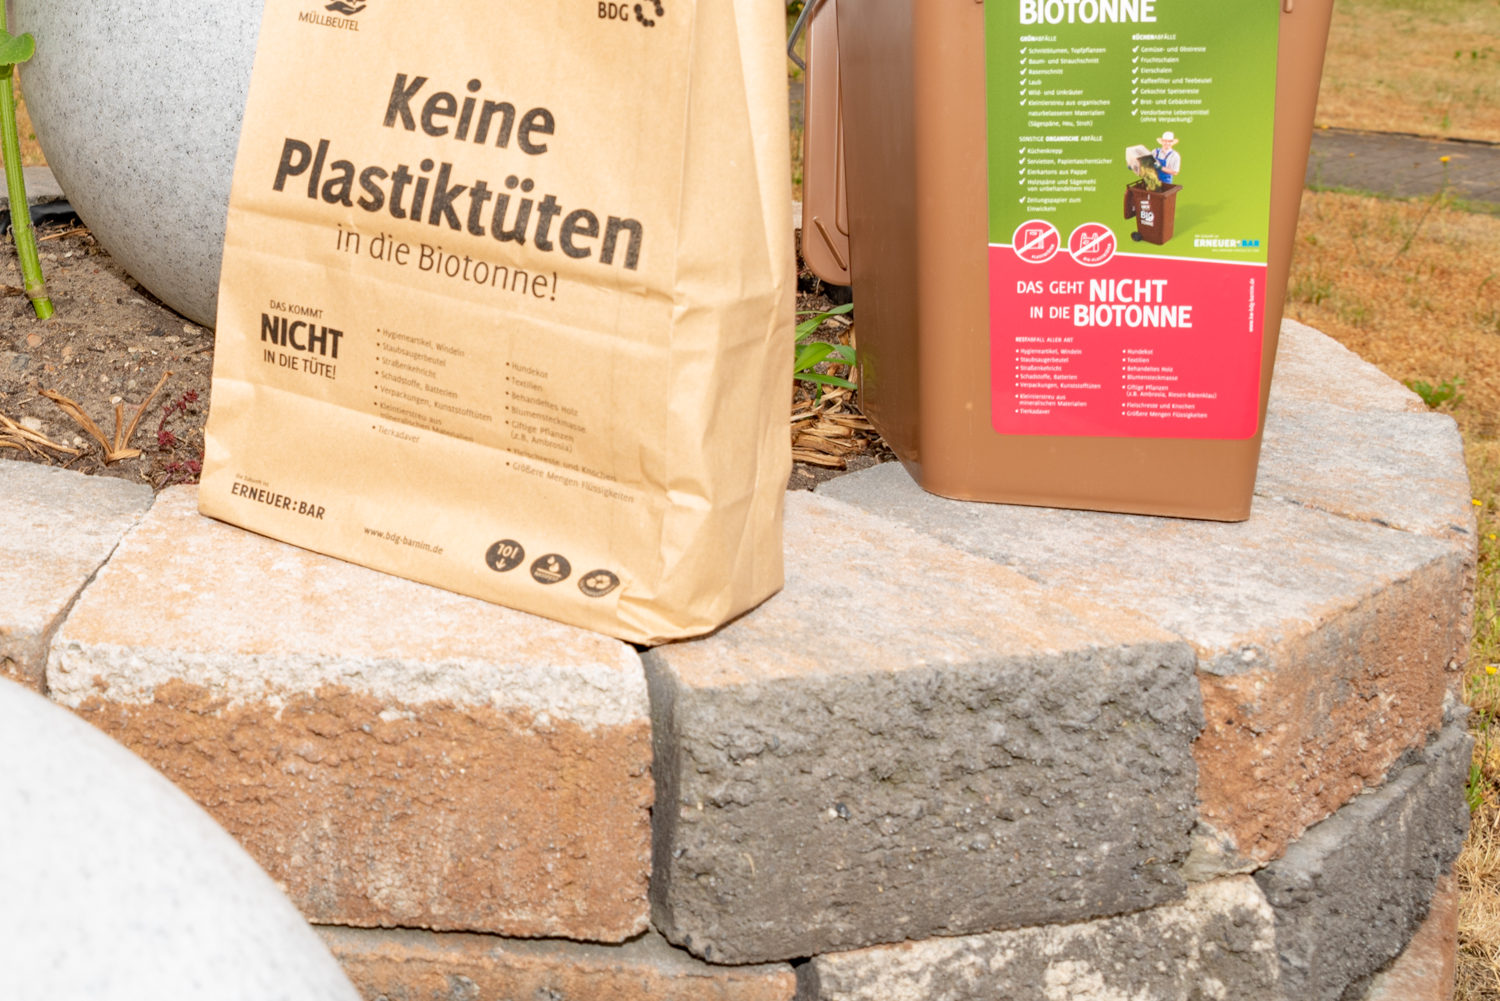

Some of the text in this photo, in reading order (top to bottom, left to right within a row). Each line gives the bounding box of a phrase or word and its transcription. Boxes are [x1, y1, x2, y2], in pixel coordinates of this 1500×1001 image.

[299, 11, 359, 32] MÜLLBEUTEL
[598, 1, 629, 22] BDG
[383, 73, 555, 156] Keine
[273, 138, 643, 271] Plastiktüten
[337, 223, 558, 302] in die Biotonne!
[1017, 279, 1168, 303] DAS GEHT NICHT
[270, 300, 323, 319] DAS KOMMT
[1030, 304, 1193, 328] IN DIE BIOTONNE
[261, 313, 344, 359] NICHT
[383, 329, 465, 357] Hygieneartikel, Windeln
[264, 349, 336, 380] IN DIE TÜTE!
[383, 342, 446, 367] Staubsaugerbeutel
[382, 357, 436, 379] Straßenkehricht
[512, 362, 548, 379] Hundekot
[381, 371, 458, 399] Schadstoffe, Batterien
[511, 376, 543, 392] Textilien
[380, 385, 492, 422] Verpackungen, Kunststofftüten
[380, 402, 443, 426] Kleintierstreu aus
[511, 391, 579, 417] Behandeltes Holz
[511, 406, 586, 434] Blumensteckmasse
[511, 420, 574, 443] Giftige Pflanzen
[379, 425, 421, 443] Tierkadaver
[511, 430, 573, 454] (z.B. Ambrosia)
[512, 462, 635, 503] Größere Mengen Flüssigkeiten
[231, 482, 326, 520] ERNEUER:BAR
[364, 528, 444, 555] www.bdg-barnim.de
